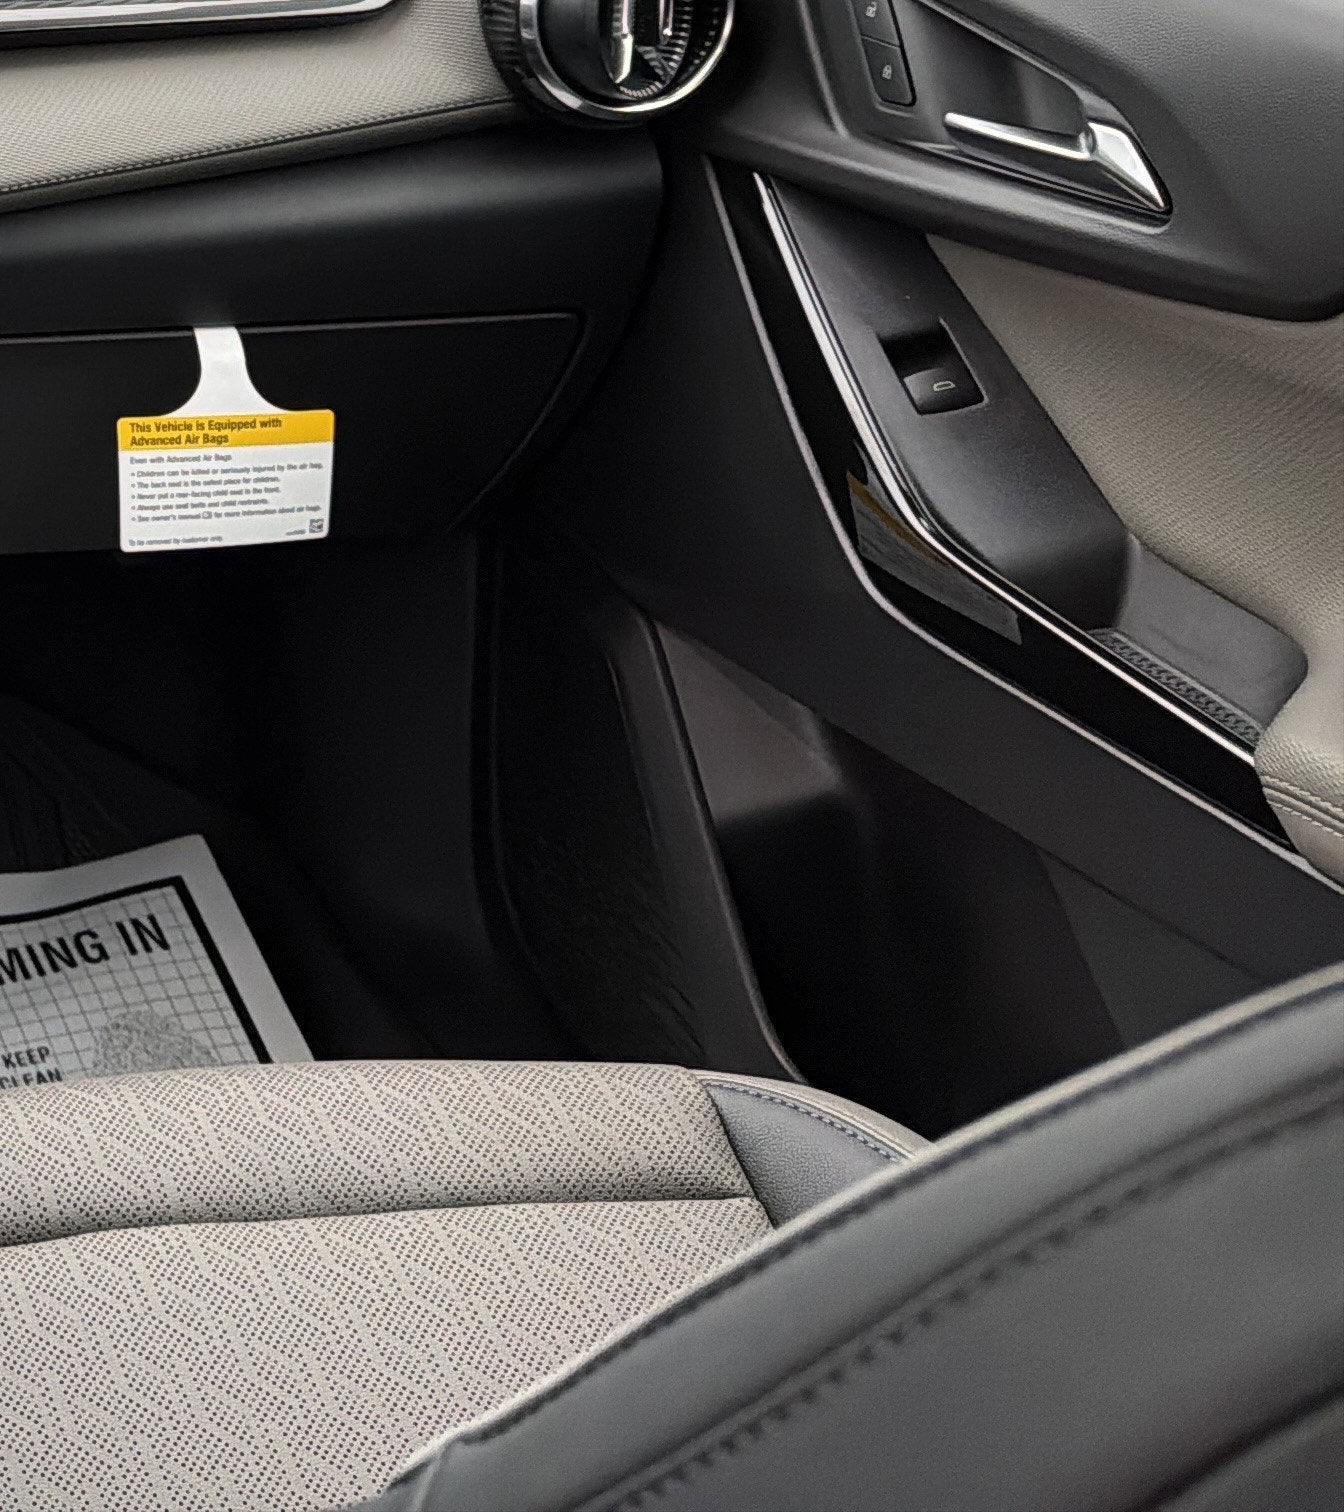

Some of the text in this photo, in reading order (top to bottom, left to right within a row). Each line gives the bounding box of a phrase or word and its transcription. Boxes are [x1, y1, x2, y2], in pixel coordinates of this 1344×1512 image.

[129, 417, 283, 433] This Vehicle is Equipped with
[130, 432, 229, 446] Advanced Air Bags
[115, 913, 172, 957] IN
[1, 1045, 51, 1070] KEEP
